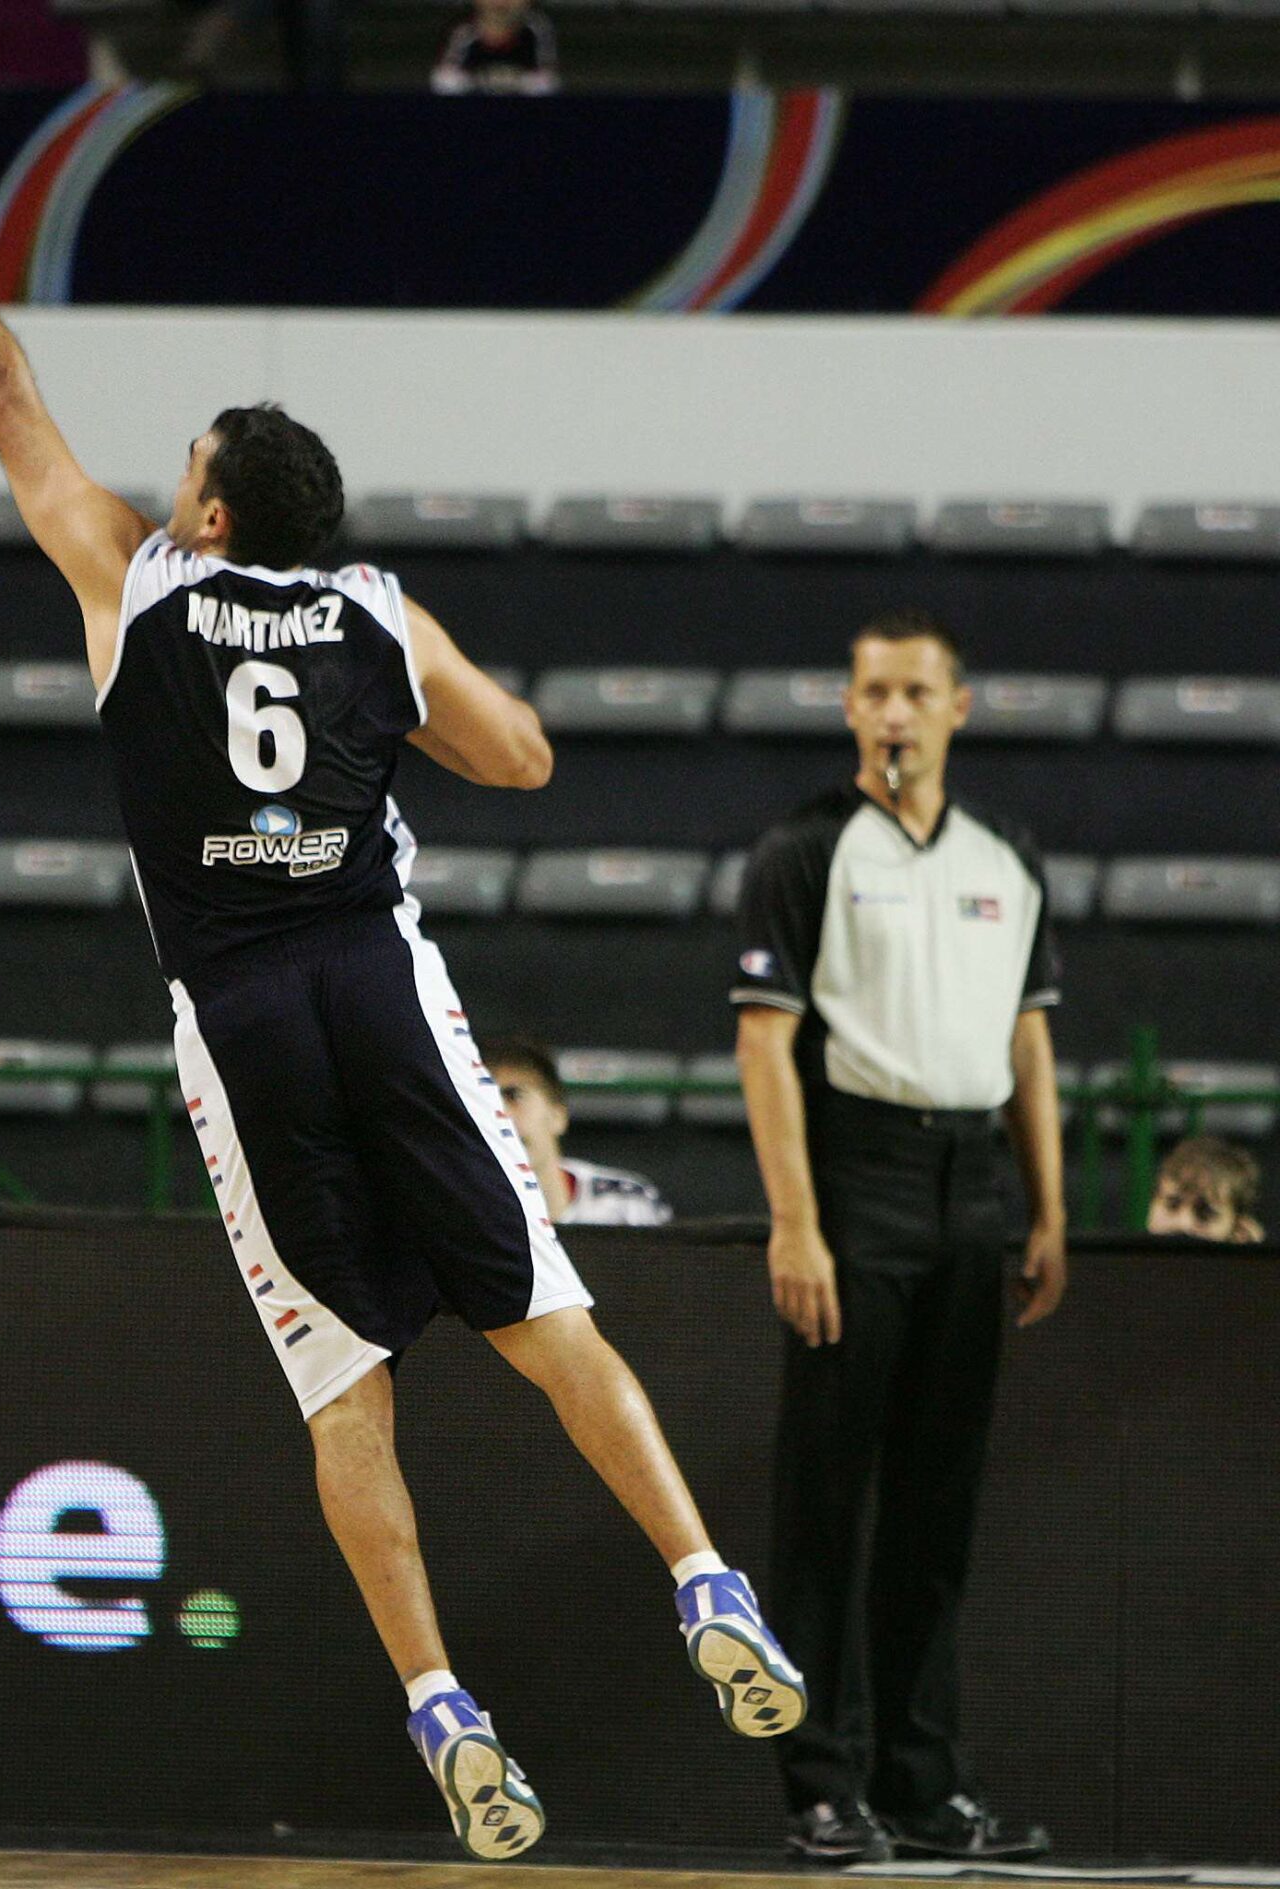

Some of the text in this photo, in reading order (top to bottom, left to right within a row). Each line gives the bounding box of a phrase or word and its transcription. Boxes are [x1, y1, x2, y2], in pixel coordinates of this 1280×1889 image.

[187, 592, 344, 652] MARTINEZ
[225, 661, 307, 793] 6
[202, 829, 349, 865] POWER
